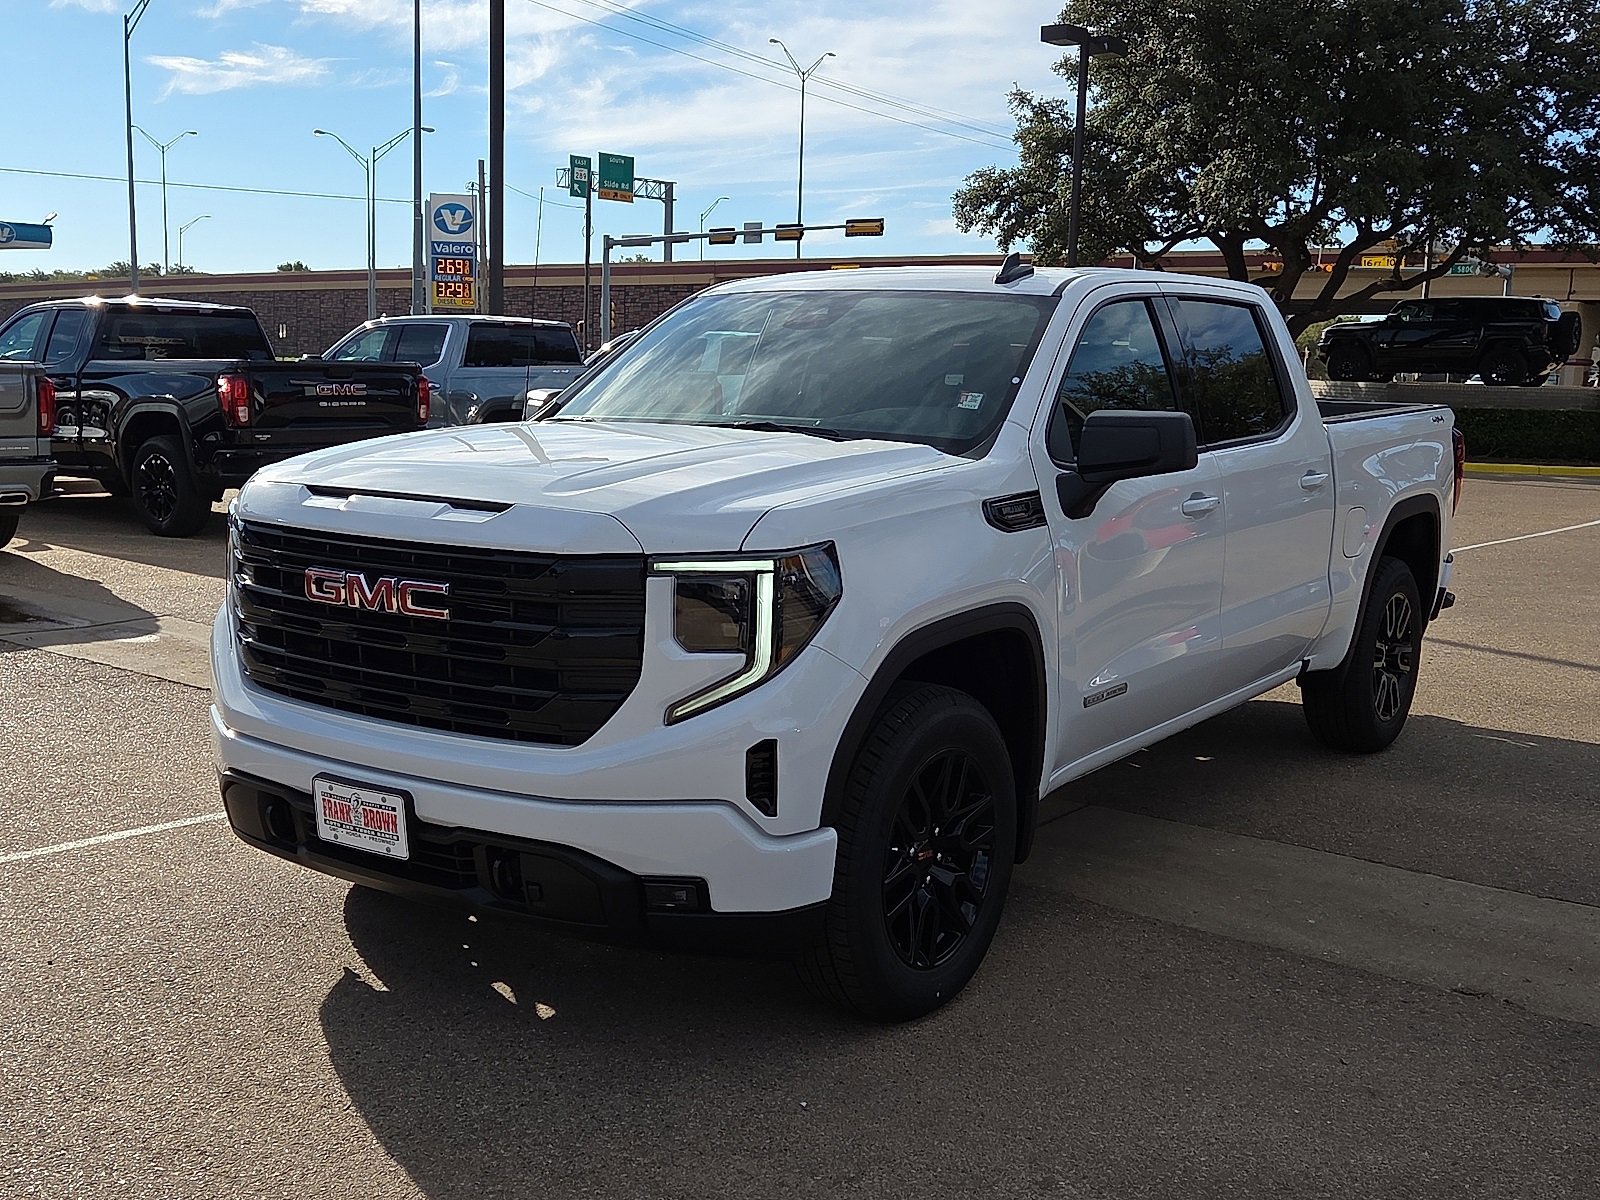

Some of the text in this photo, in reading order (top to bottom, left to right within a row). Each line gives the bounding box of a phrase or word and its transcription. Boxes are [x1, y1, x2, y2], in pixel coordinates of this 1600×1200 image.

[603, 180, 630, 190] Slide Rd
[433, 243, 474, 254] Valero
[1363, 259, 1373, 267] 16
[316, 383, 368, 396] GMC
[304, 566, 450, 621] GMC
[322, 797, 353, 825] FRANK
[361, 807, 399, 834] BROWN
[326, 819, 341, 828] AUTO
